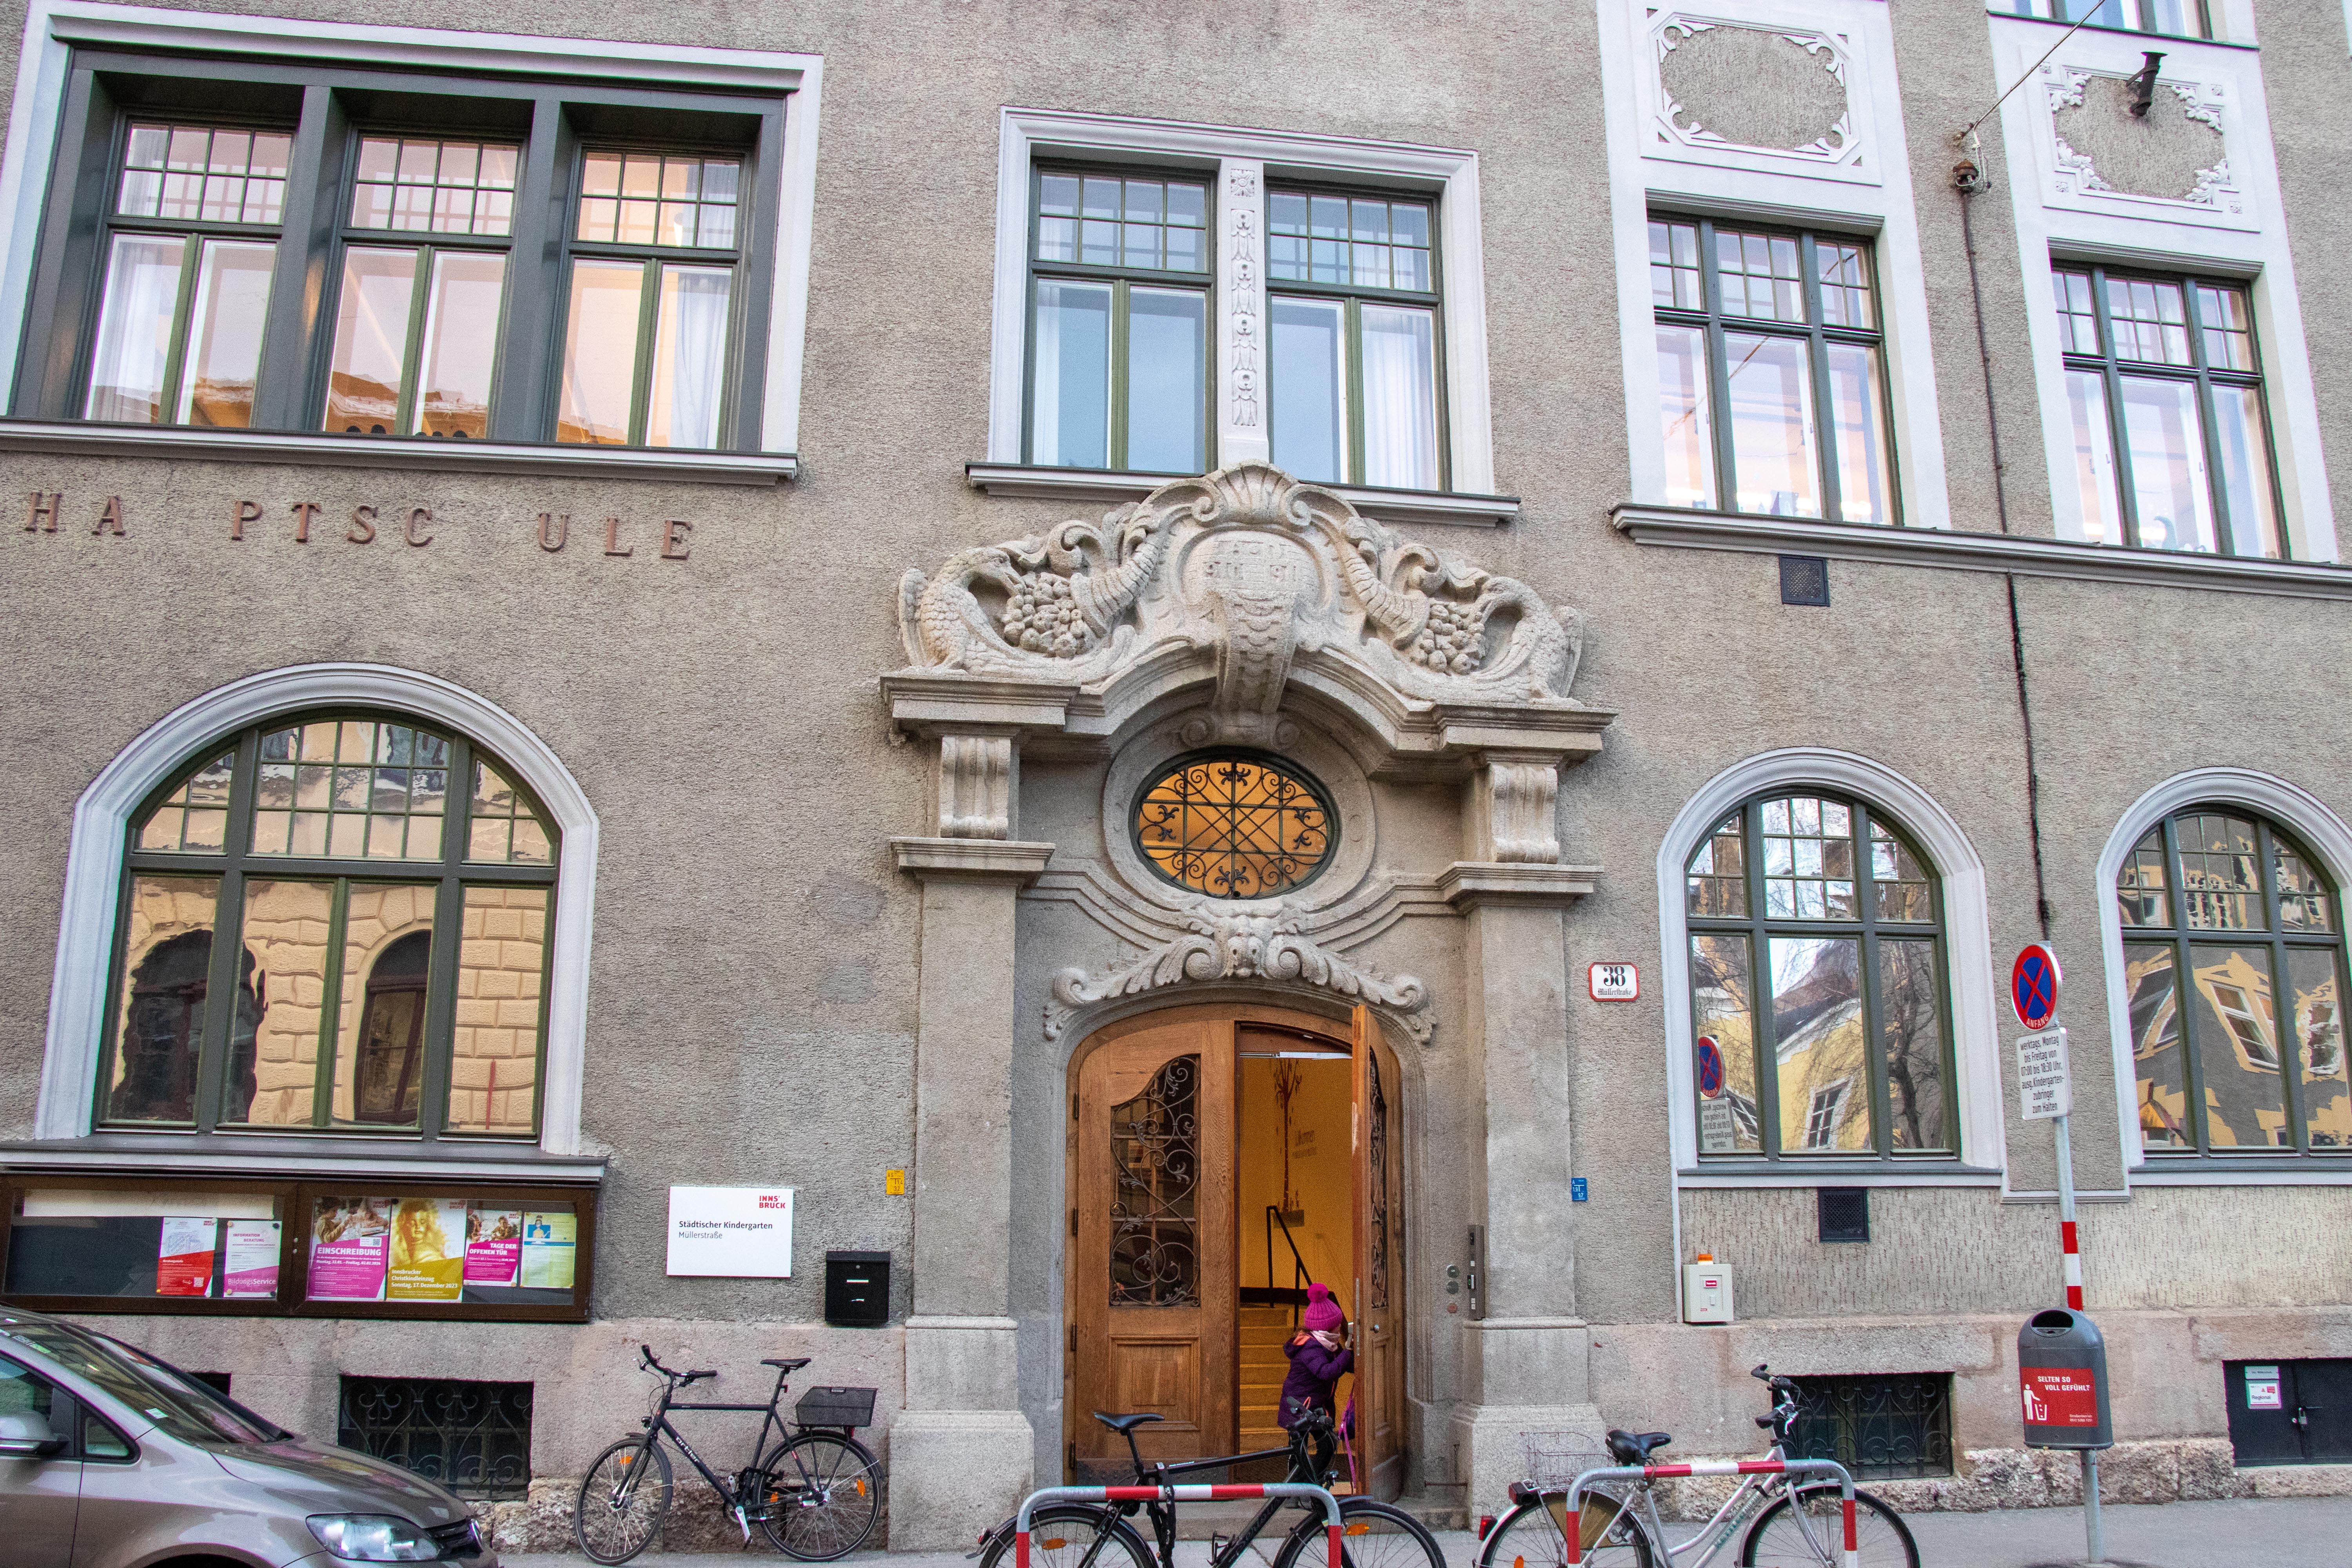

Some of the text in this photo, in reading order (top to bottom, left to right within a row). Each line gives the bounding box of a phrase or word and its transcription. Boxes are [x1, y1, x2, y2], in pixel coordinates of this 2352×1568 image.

[1603, 965, 1626, 987] 38
[1597, 987, 1632, 996] Müllerstraße
[2026, 1013, 2049, 1028] ANFANG
[2042, 1036, 2059, 1046] Montag
[2032, 1051, 2047, 1062] Freitag
[2048, 1050, 2057, 1058] von
[2021, 1065, 2032, 1076] 07:00
[2041, 1062, 2052, 1073] 18:30
[2033, 1089, 2054, 1100] zubringer
[2033, 1102, 2057, 1113] zum Halten
[724, 1221, 773, 1230] Kindergarten
[317, 1247, 382, 1256] EINSCHREIBUNG
